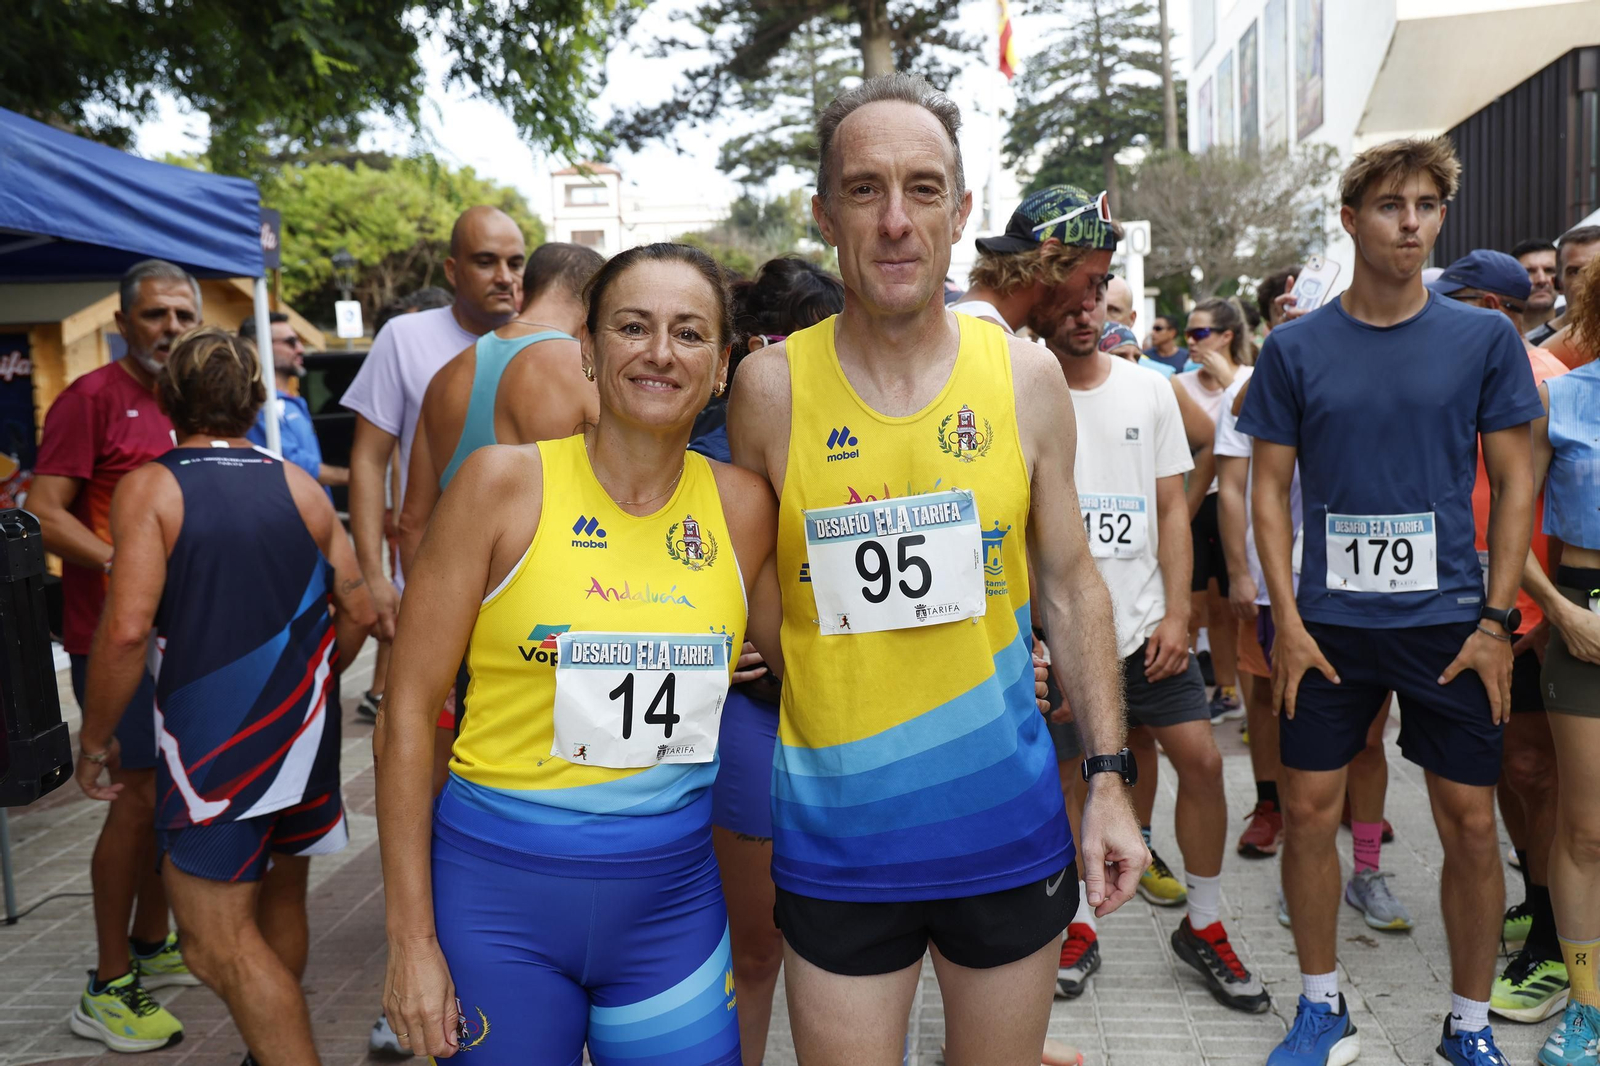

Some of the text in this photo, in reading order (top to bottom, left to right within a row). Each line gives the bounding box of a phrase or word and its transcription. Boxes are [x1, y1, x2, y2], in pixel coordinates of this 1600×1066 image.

[826, 449, 860, 463] mobel
[816, 501, 962, 539] DESAFÍO ELA TARIFA
[1083, 512, 1131, 544] 152
[1334, 520, 1424, 537] DESAFÍO ELA TARIFA
[571, 539, 608, 549] mobel
[1345, 538, 1414, 576] 179
[855, 534, 932, 604] 95
[585, 576, 697, 609] Andalucía
[927, 604, 961, 615] TARIFA
[518, 645, 558, 667] Vop
[571, 639, 714, 671] DESAFÍO ELA TARIFA
[609, 672, 680, 740] 14
[666, 746, 695, 754] TARIFA
